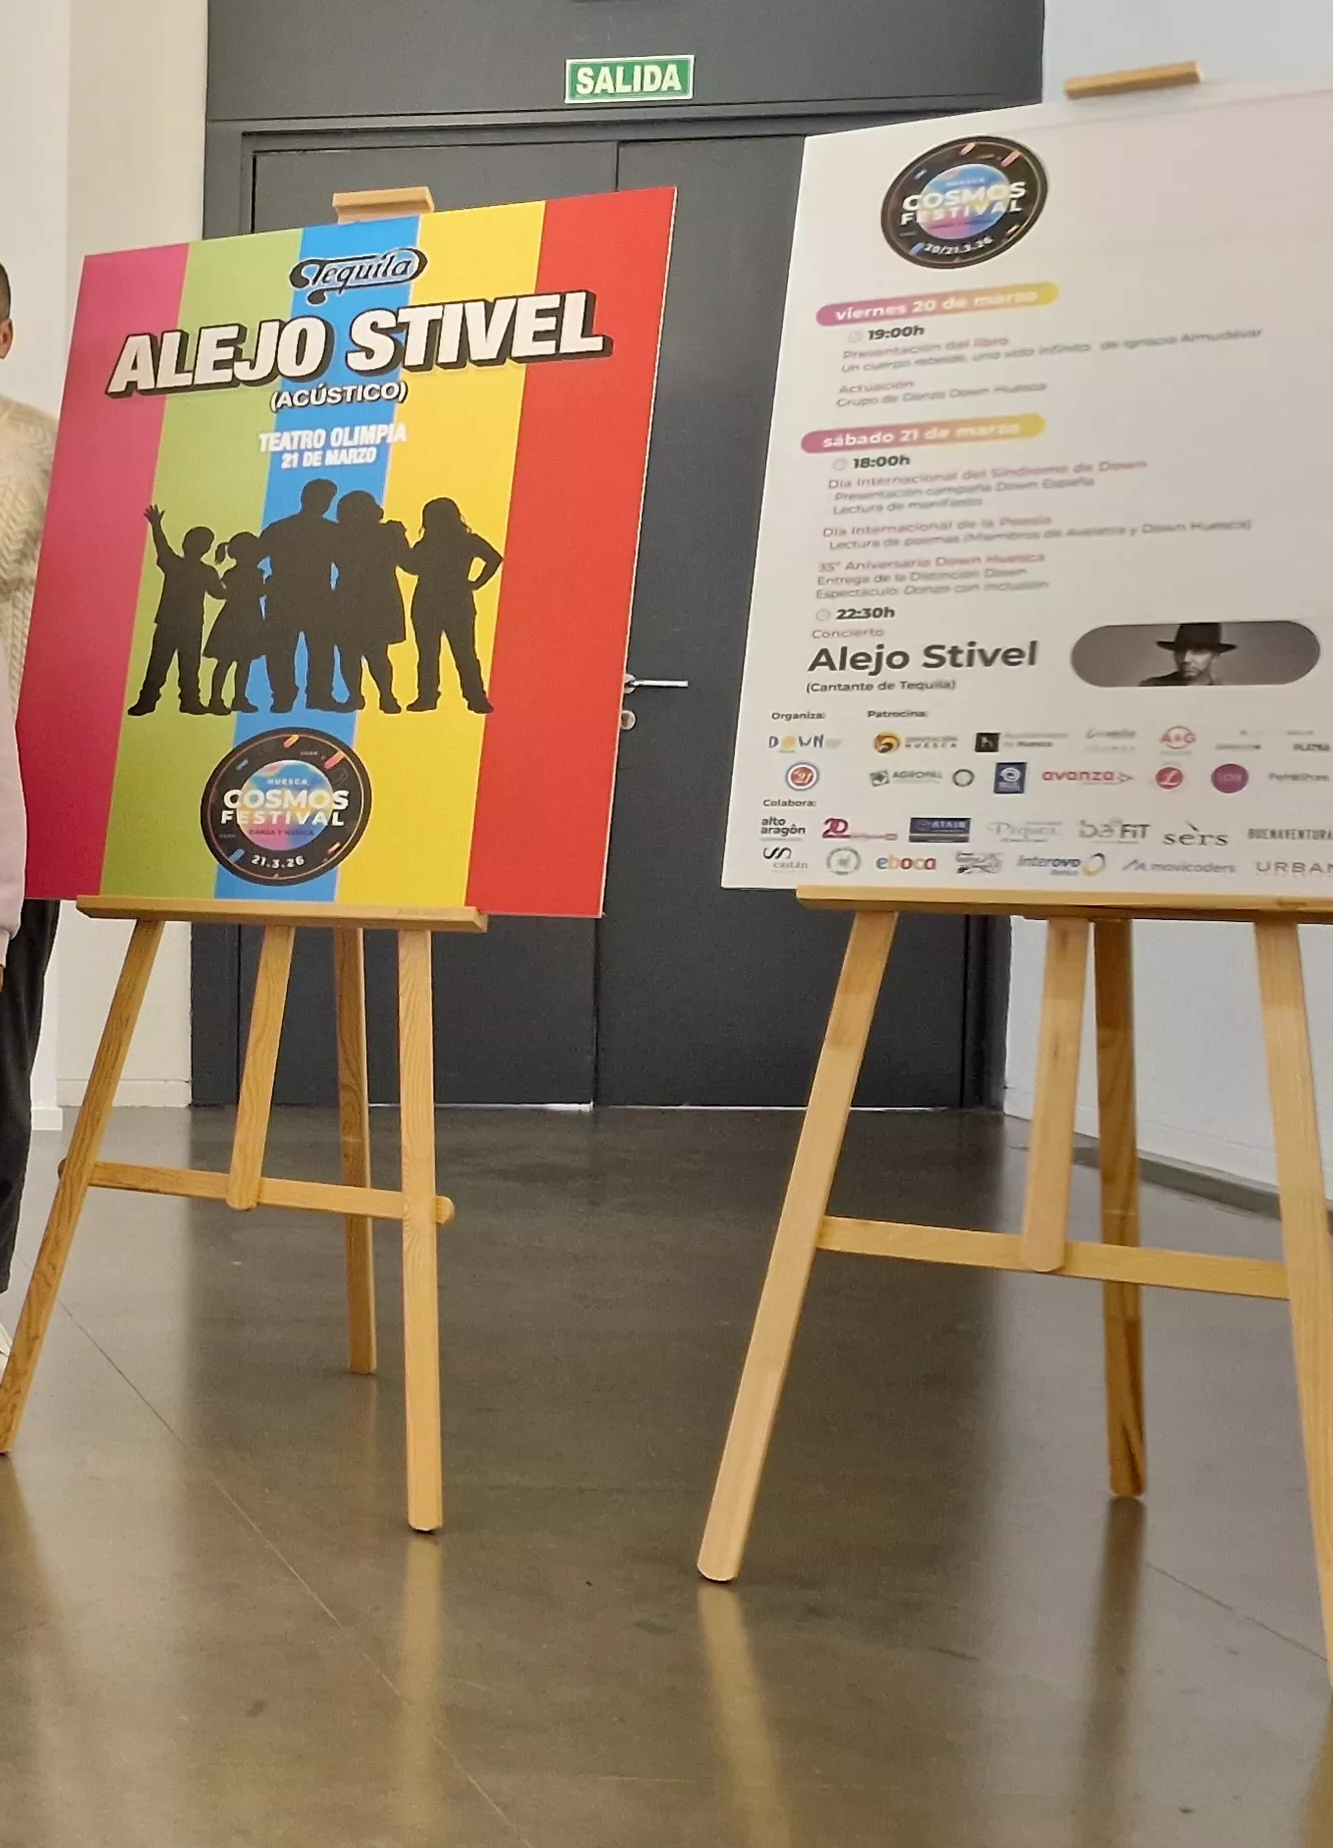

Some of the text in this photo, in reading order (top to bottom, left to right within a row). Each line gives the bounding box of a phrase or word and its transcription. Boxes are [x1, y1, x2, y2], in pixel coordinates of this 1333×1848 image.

[576, 64, 681, 94] SALIDA
[902, 181, 1027, 211] COSMOS
[900, 200, 1022, 225] FESTIVAL
[291, 249, 425, 299] Tequila
[836, 305, 906, 321] viernes
[912, 301, 936, 314] 20
[942, 297, 967, 310] de
[867, 325, 925, 341] 19:00h
[107, 291, 611, 396] ALEJO STIVEL
[270, 381, 407, 412] (ACÚSTICO)
[259, 422, 407, 453] TEATRO OLIMPIA
[823, 432, 894, 448] sábado
[899, 429, 918, 442] 21
[924, 426, 950, 439] de
[281, 447, 377, 468] 21 DE MARZO
[853, 454, 910, 469] 18:00h
[836, 607, 896, 620] 22:30h
[812, 627, 885, 640] Concierto
[807, 640, 1039, 676] Alejo Stivel
[806, 679, 956, 694] (Cantante de Tequila)
[771, 711, 826, 721] Organiza:
[867, 709, 930, 719] Patrocina:
[1041, 770, 1115, 781] avanza
[223, 789, 350, 811] COSMOS
[763, 799, 817, 808] Colabora:
[221, 809, 345, 827] FESTIVAL
[761, 816, 786, 826] alto
[251, 854, 305, 869] 21.3.26
[876, 856, 937, 871] eboca
[1151, 861, 1236, 874] movicoders
